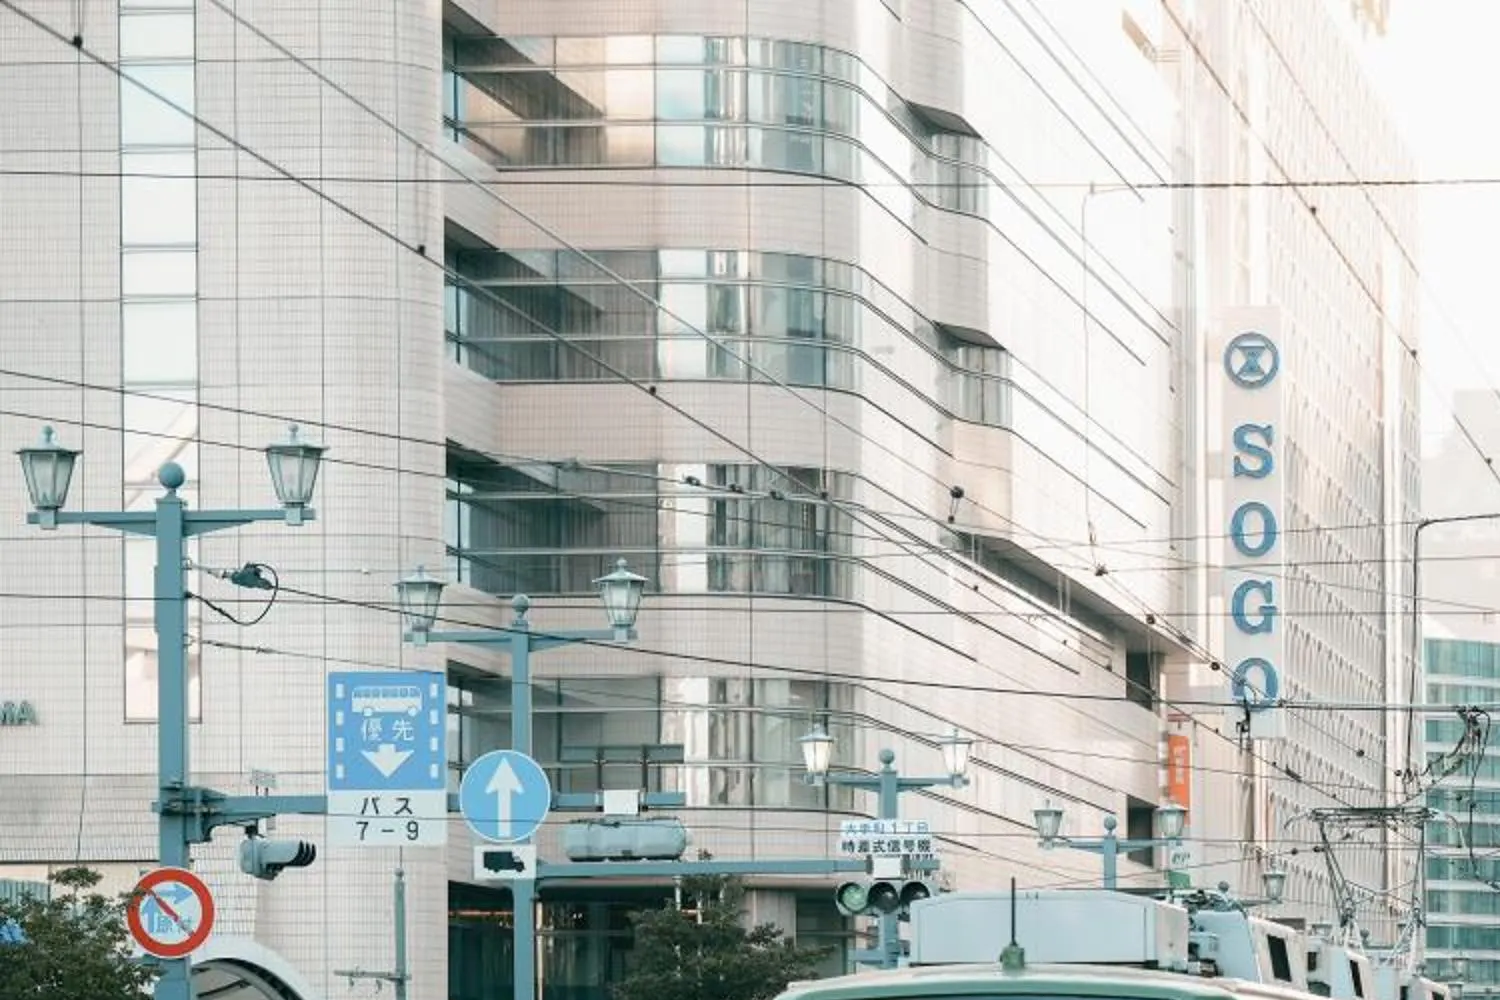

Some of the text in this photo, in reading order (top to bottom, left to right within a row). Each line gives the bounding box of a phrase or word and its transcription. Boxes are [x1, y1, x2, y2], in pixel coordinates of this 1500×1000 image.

[1230, 423, 1279, 712] SOGO
[361, 717, 415, 742] 優先
[361, 796, 413, 815] バス
